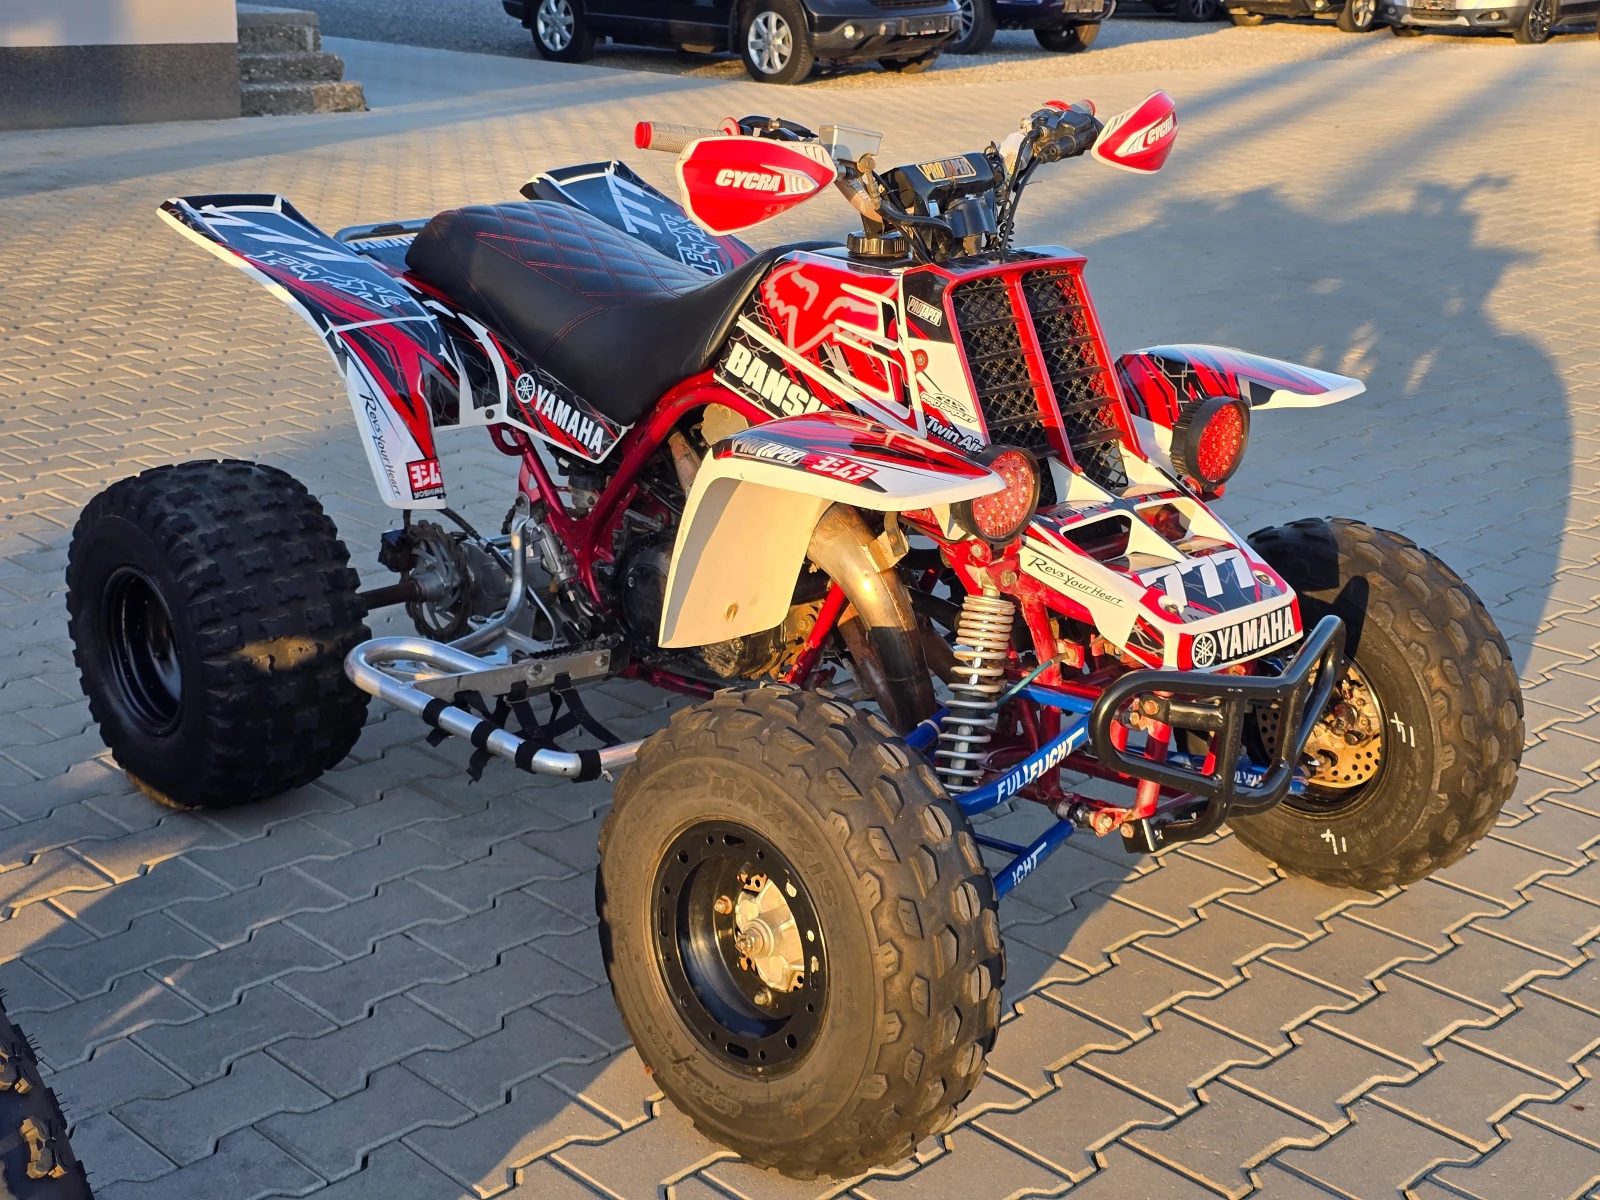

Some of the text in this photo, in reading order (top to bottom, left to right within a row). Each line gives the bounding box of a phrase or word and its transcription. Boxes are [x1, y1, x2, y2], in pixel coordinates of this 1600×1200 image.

[715, 169, 782, 192] CYCRA
[342, 236, 416, 252] YAMAH
[359, 391, 382, 433] Revs
[535, 384, 604, 455] YAMAHA
[926, 416, 960, 443] Twin
[958, 435, 983, 453] Air
[1027, 554, 1066, 579] Revs
[1138, 548, 1256, 608] 777
[1216, 606, 1296, 661] YAMAHA
[710, 776, 839, 908] MAXXIS
